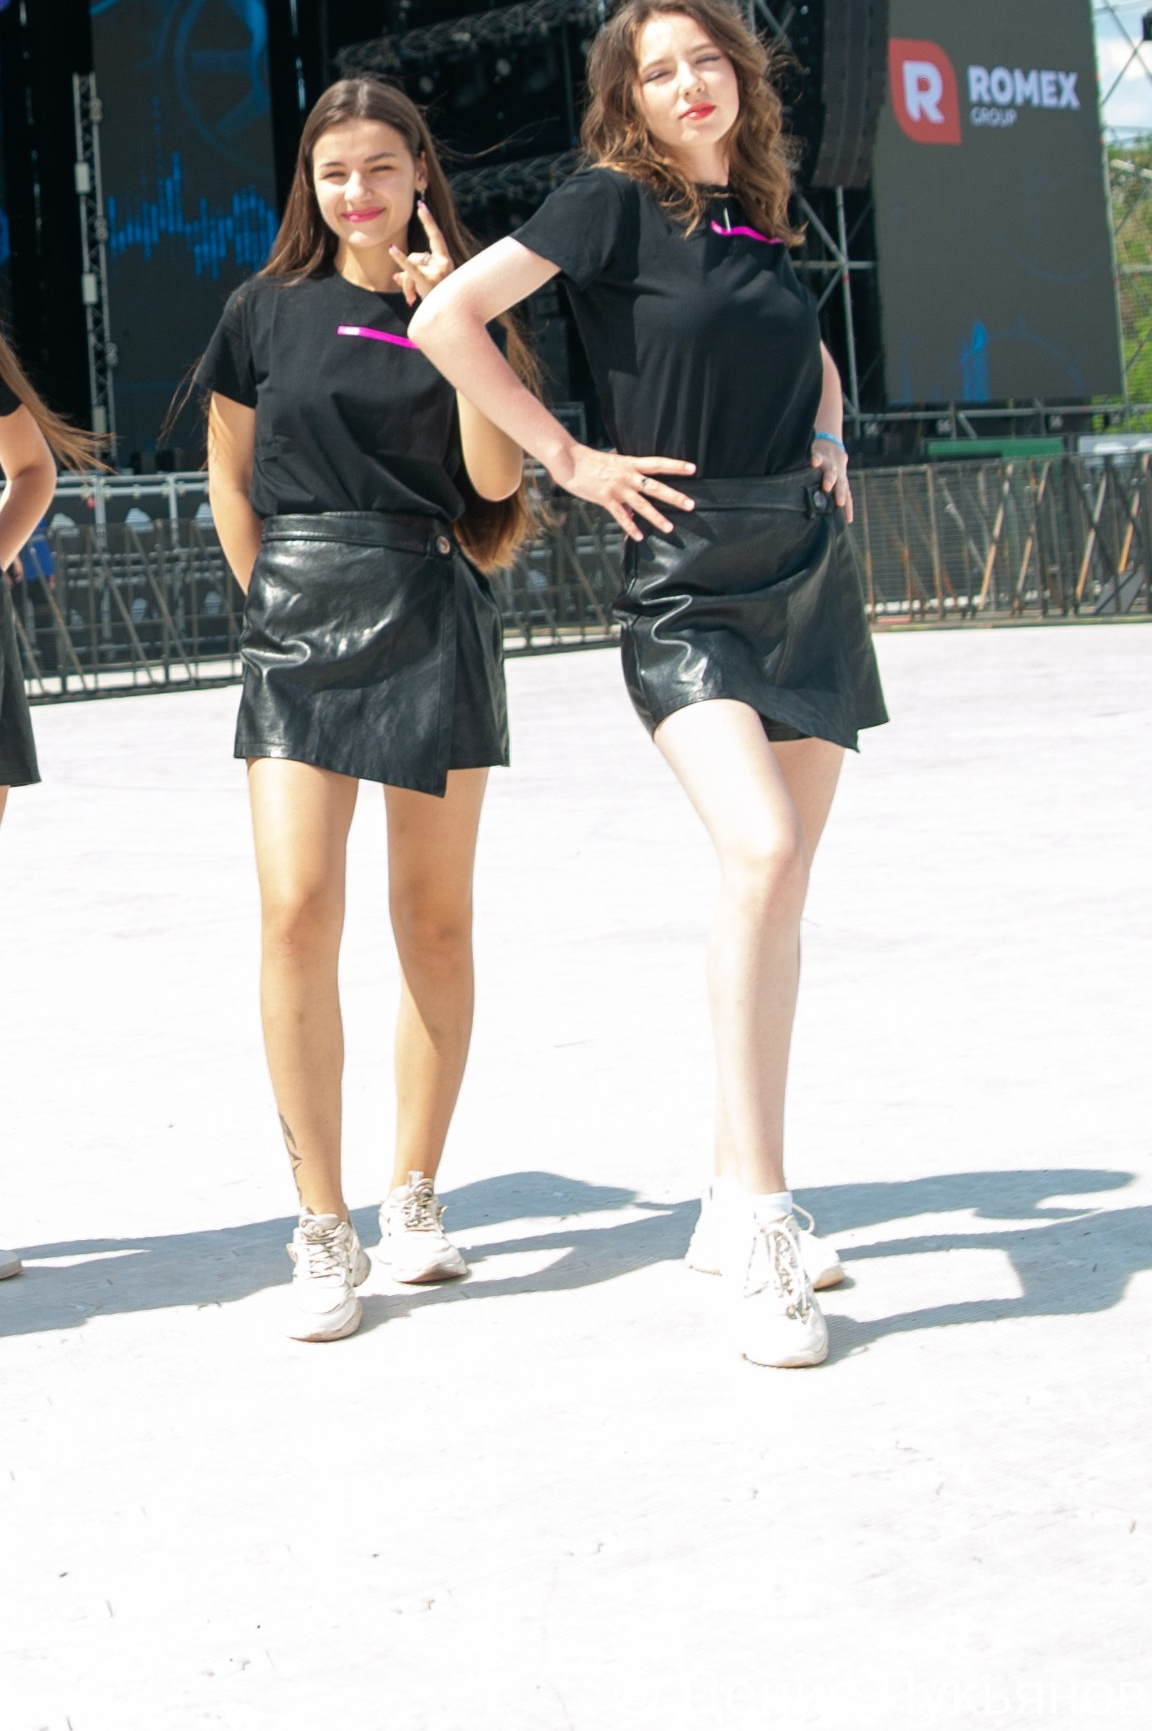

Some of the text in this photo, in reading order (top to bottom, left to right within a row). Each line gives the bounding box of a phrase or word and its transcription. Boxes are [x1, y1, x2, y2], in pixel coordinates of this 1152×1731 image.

[902, 60, 946, 124] R
[966, 65, 1081, 111] ROMEX
[970, 107, 1018, 127] GROUP
